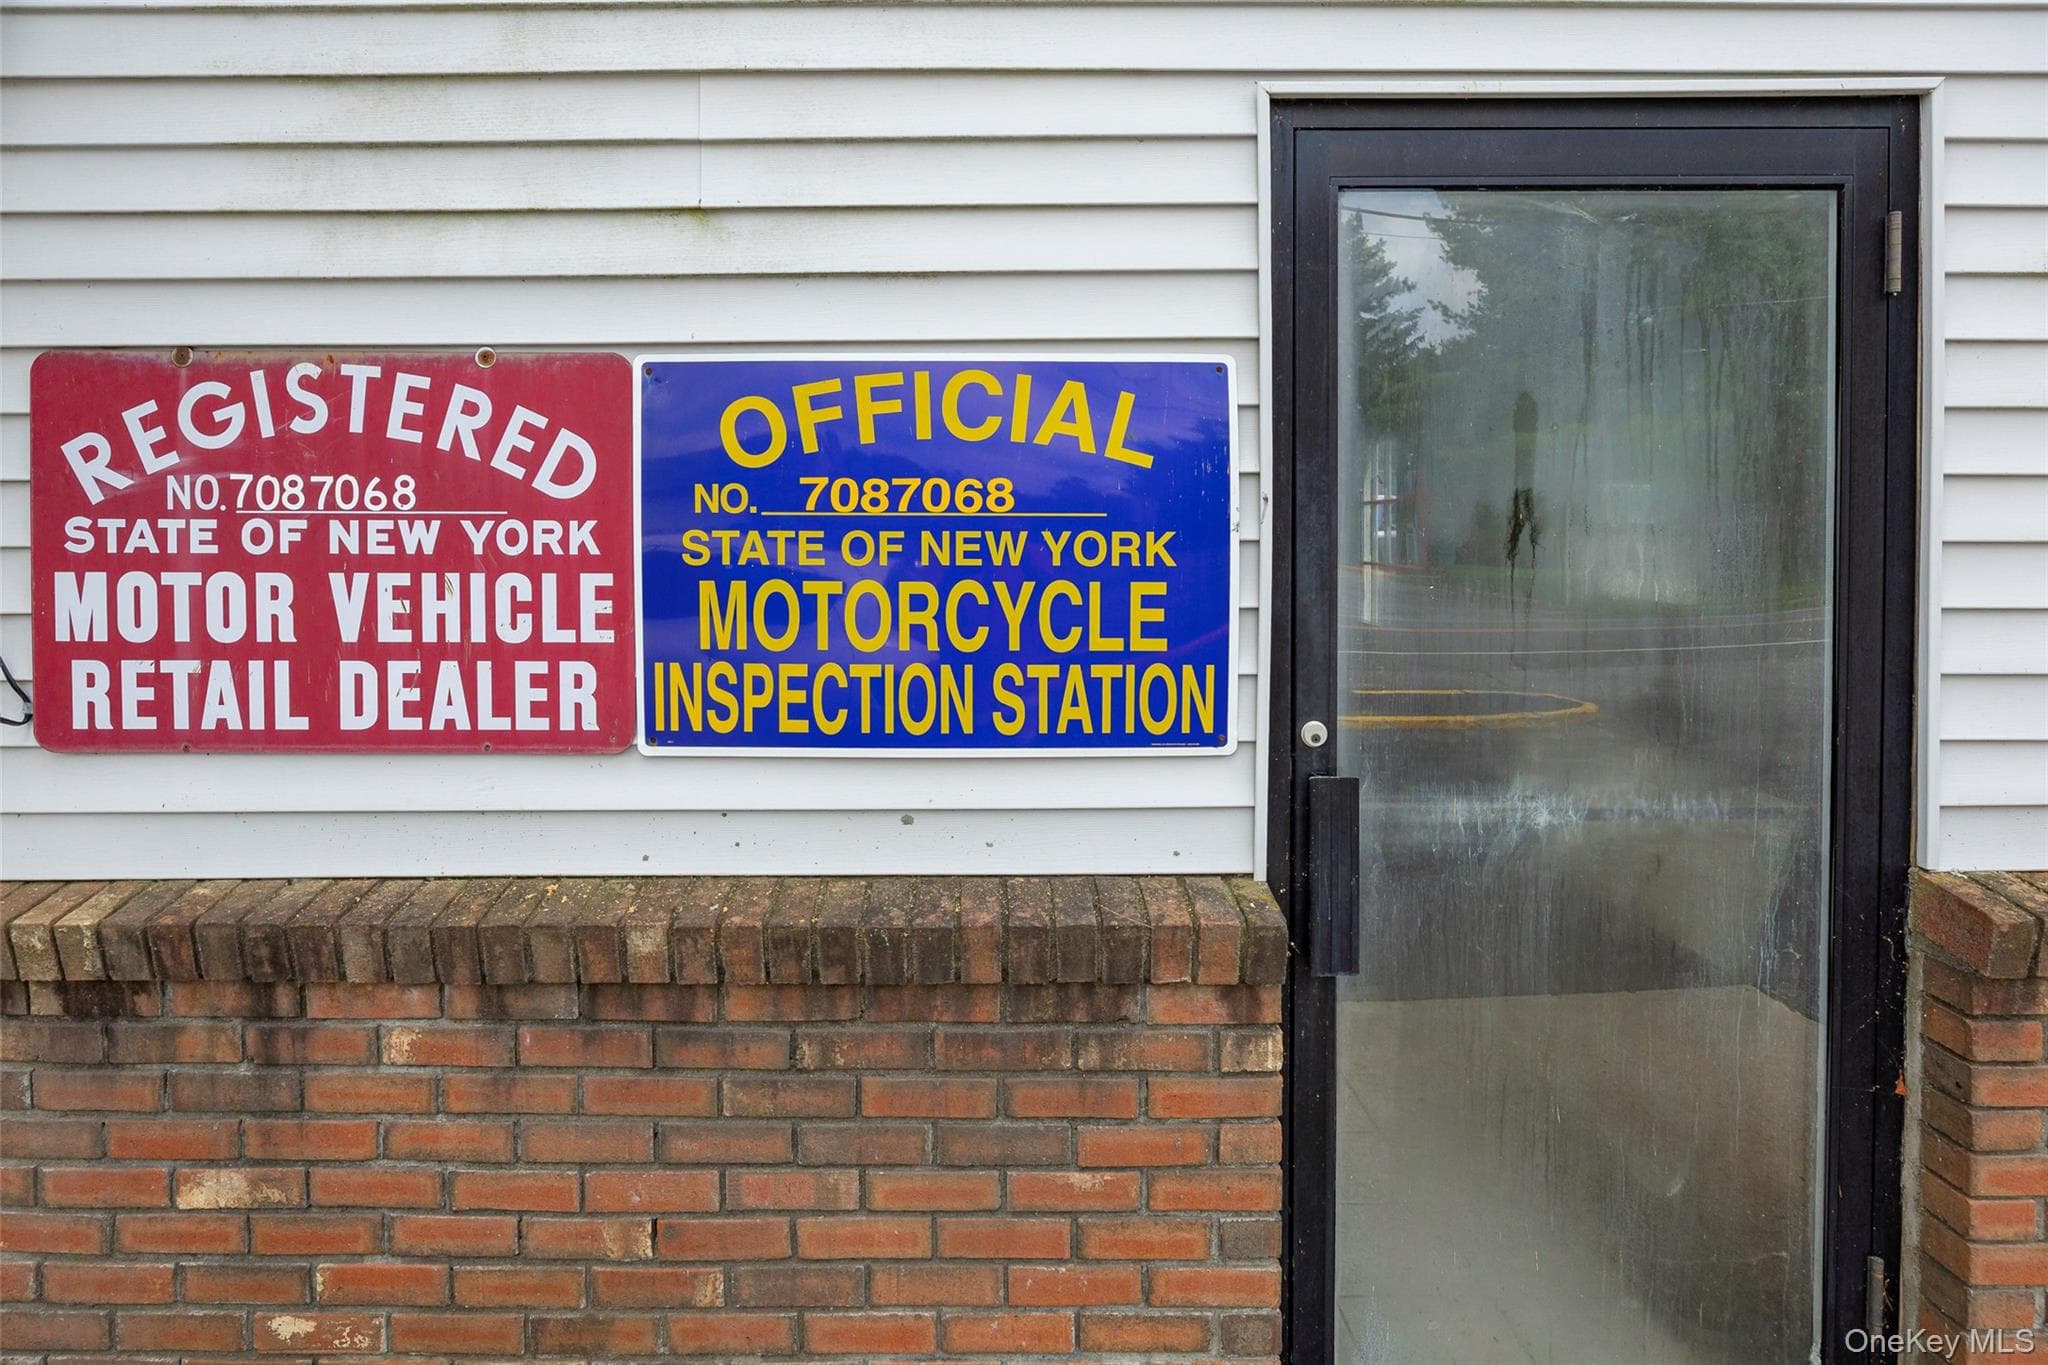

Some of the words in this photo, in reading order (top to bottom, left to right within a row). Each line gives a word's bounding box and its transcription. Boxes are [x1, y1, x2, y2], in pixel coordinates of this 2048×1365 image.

[60, 363, 597, 505] REGISTERED
[719, 369, 1155, 470] OFFICIAL
[694, 483, 757, 514] NO.
[799, 477, 1015, 513] 7087068
[63, 516, 219, 554] STATE
[241, 518, 307, 555] OF
[329, 519, 441, 555] NEW
[459, 519, 600, 556] YORK
[681, 529, 826, 567] STATE
[840, 530, 905, 567] OF
[920, 531, 1026, 567] NEW
[1041, 531, 1177, 568] YORK
[53, 571, 297, 643] MOTOR
[328, 572, 615, 643] VEHICLE
[698, 579, 1168, 653] MOTORCYCLE
[71, 660, 309, 730] RETAIL
[339, 660, 600, 731] DEALER
[654, 661, 974, 735] INSPECTION
[992, 662, 1215, 736] STATION
